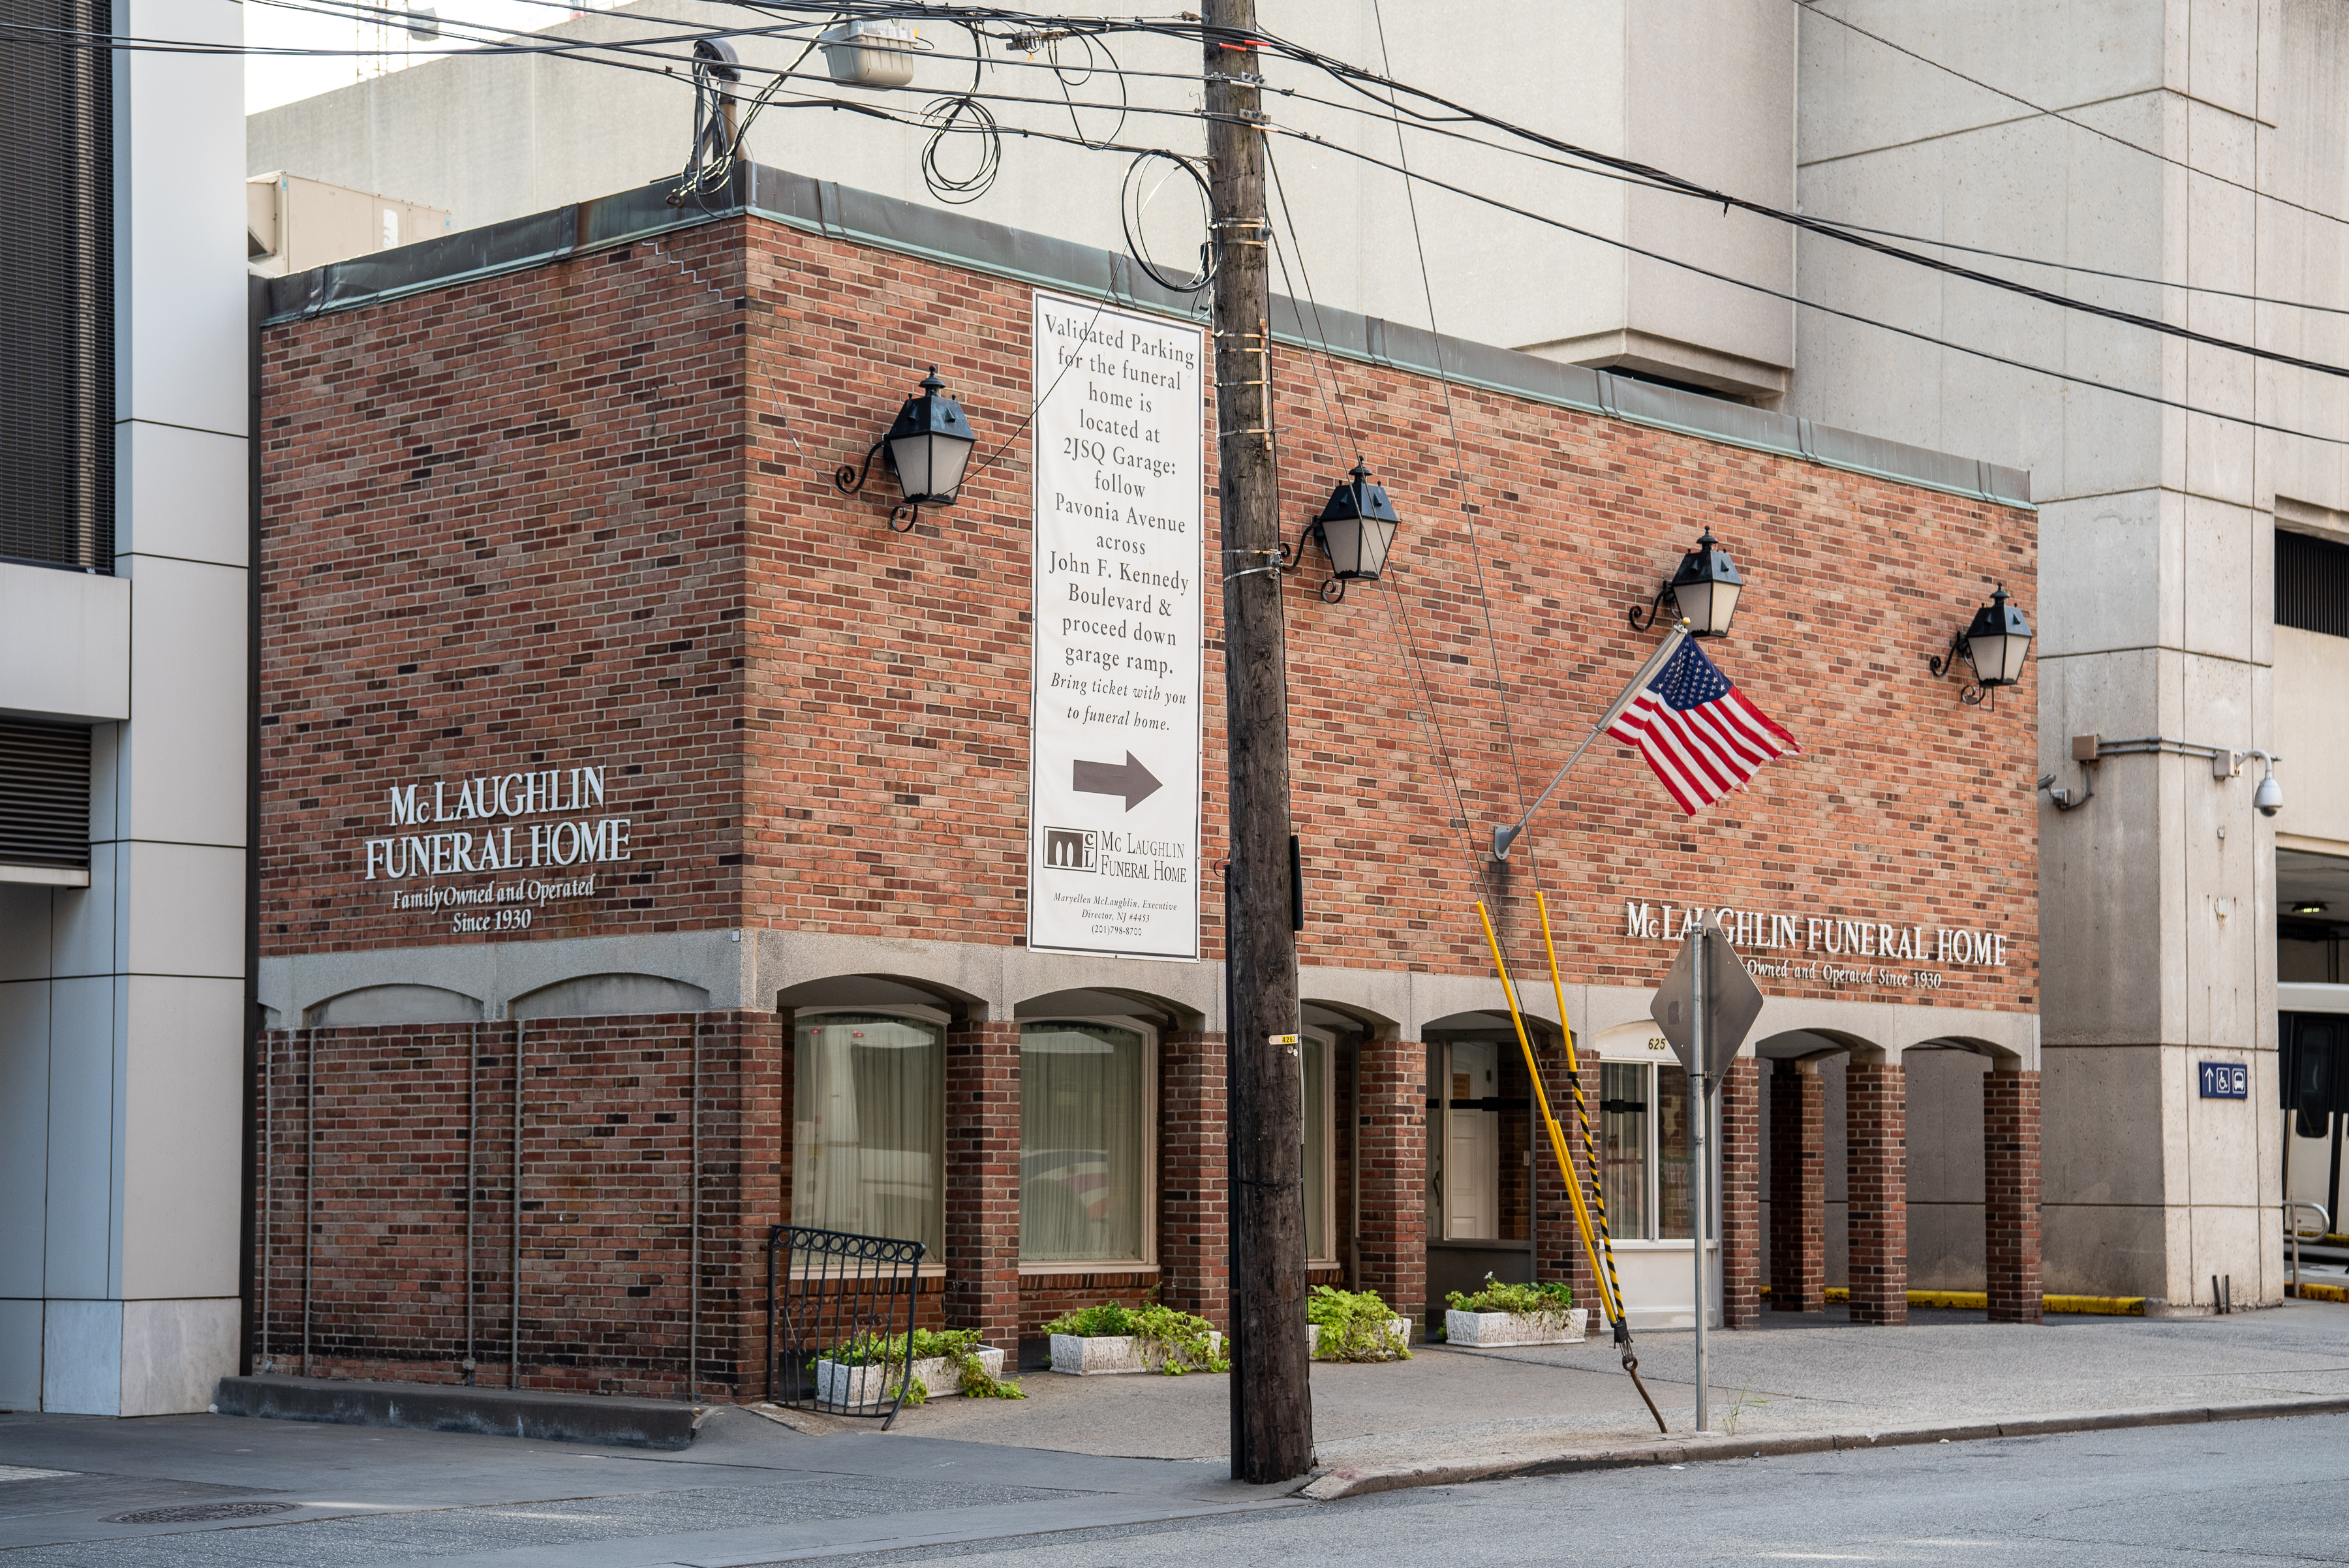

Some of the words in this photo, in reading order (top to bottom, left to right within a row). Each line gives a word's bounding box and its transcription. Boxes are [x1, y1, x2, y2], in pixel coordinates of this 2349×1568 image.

[1045, 314, 1124, 348] Validated
[1131, 334, 1194, 369] Parking
[1058, 346, 1082, 368] for
[1090, 354, 1115, 375] the
[1123, 360, 1180, 390] funeral
[1089, 382, 1133, 408] home
[1140, 393, 1152, 412] is
[1081, 409, 1138, 438] located
[1146, 427, 1160, 442] at
[1064, 437, 1105, 465] 2JSQ
[1113, 446, 1175, 478] Garage:
[1095, 470, 1145, 497] follow
[1056, 493, 1119, 521] Pavonia
[1126, 506, 1185, 532] Avenue
[1096, 536, 1145, 555] across
[1049, 551, 1090, 574] John
[1098, 559, 1111, 578] F.
[1120, 562, 1189, 596] Kennedy
[1069, 583, 1151, 613] Boulevard
[1159, 598, 1172, 617] &
[1062, 617, 1126, 638] proceed
[1134, 622, 1176, 646] down
[1066, 647, 1119, 671] garage
[1127, 656, 1173, 679] ramp.
[1051, 673, 1087, 695] Bring
[1092, 679, 1128, 696] ticket
[1133, 686, 1160, 701] with
[1165, 693, 1186, 706] you
[1067, 707, 1079, 719] to
[1082, 705, 1130, 725] funeral
[1134, 712, 1169, 730] home.
[390, 766, 606, 826] McLAUGHLIN
[365, 827, 523, 880] FUNERAL
[530, 819, 631, 867] HOME
[1128, 833, 1184, 858] LAUGHLIN
[1101, 855, 1150, 879] FUNERAL
[1154, 860, 1186, 882] HOME
[497, 878, 525, 901] and
[528, 874, 596, 907] Operated
[1054, 893, 1091, 904] Maryellen
[1094, 896, 1139, 909] McLaughlin,
[1143, 900, 1177, 910] Executive
[453, 912, 491, 932] Since
[495, 908, 532, 930] 1930
[1082, 910, 1114, 921] Director,
[1117, 912, 1127, 923] NJ
[1129, 914, 1150, 922] #4453
[1092, 925, 1142, 936] (201)798-8700
[1807, 917, 1929, 960] FUNERAL
[1937, 929, 2007, 966] HOME
[1747, 959, 1789, 978] Owned
[1794, 961, 1817, 979] and
[1823, 964, 1873, 988] Operated
[1879, 968, 1908, 986] Since
[1913, 972, 1942, 989] 1930
[1648, 1038, 1666, 1050] 625
